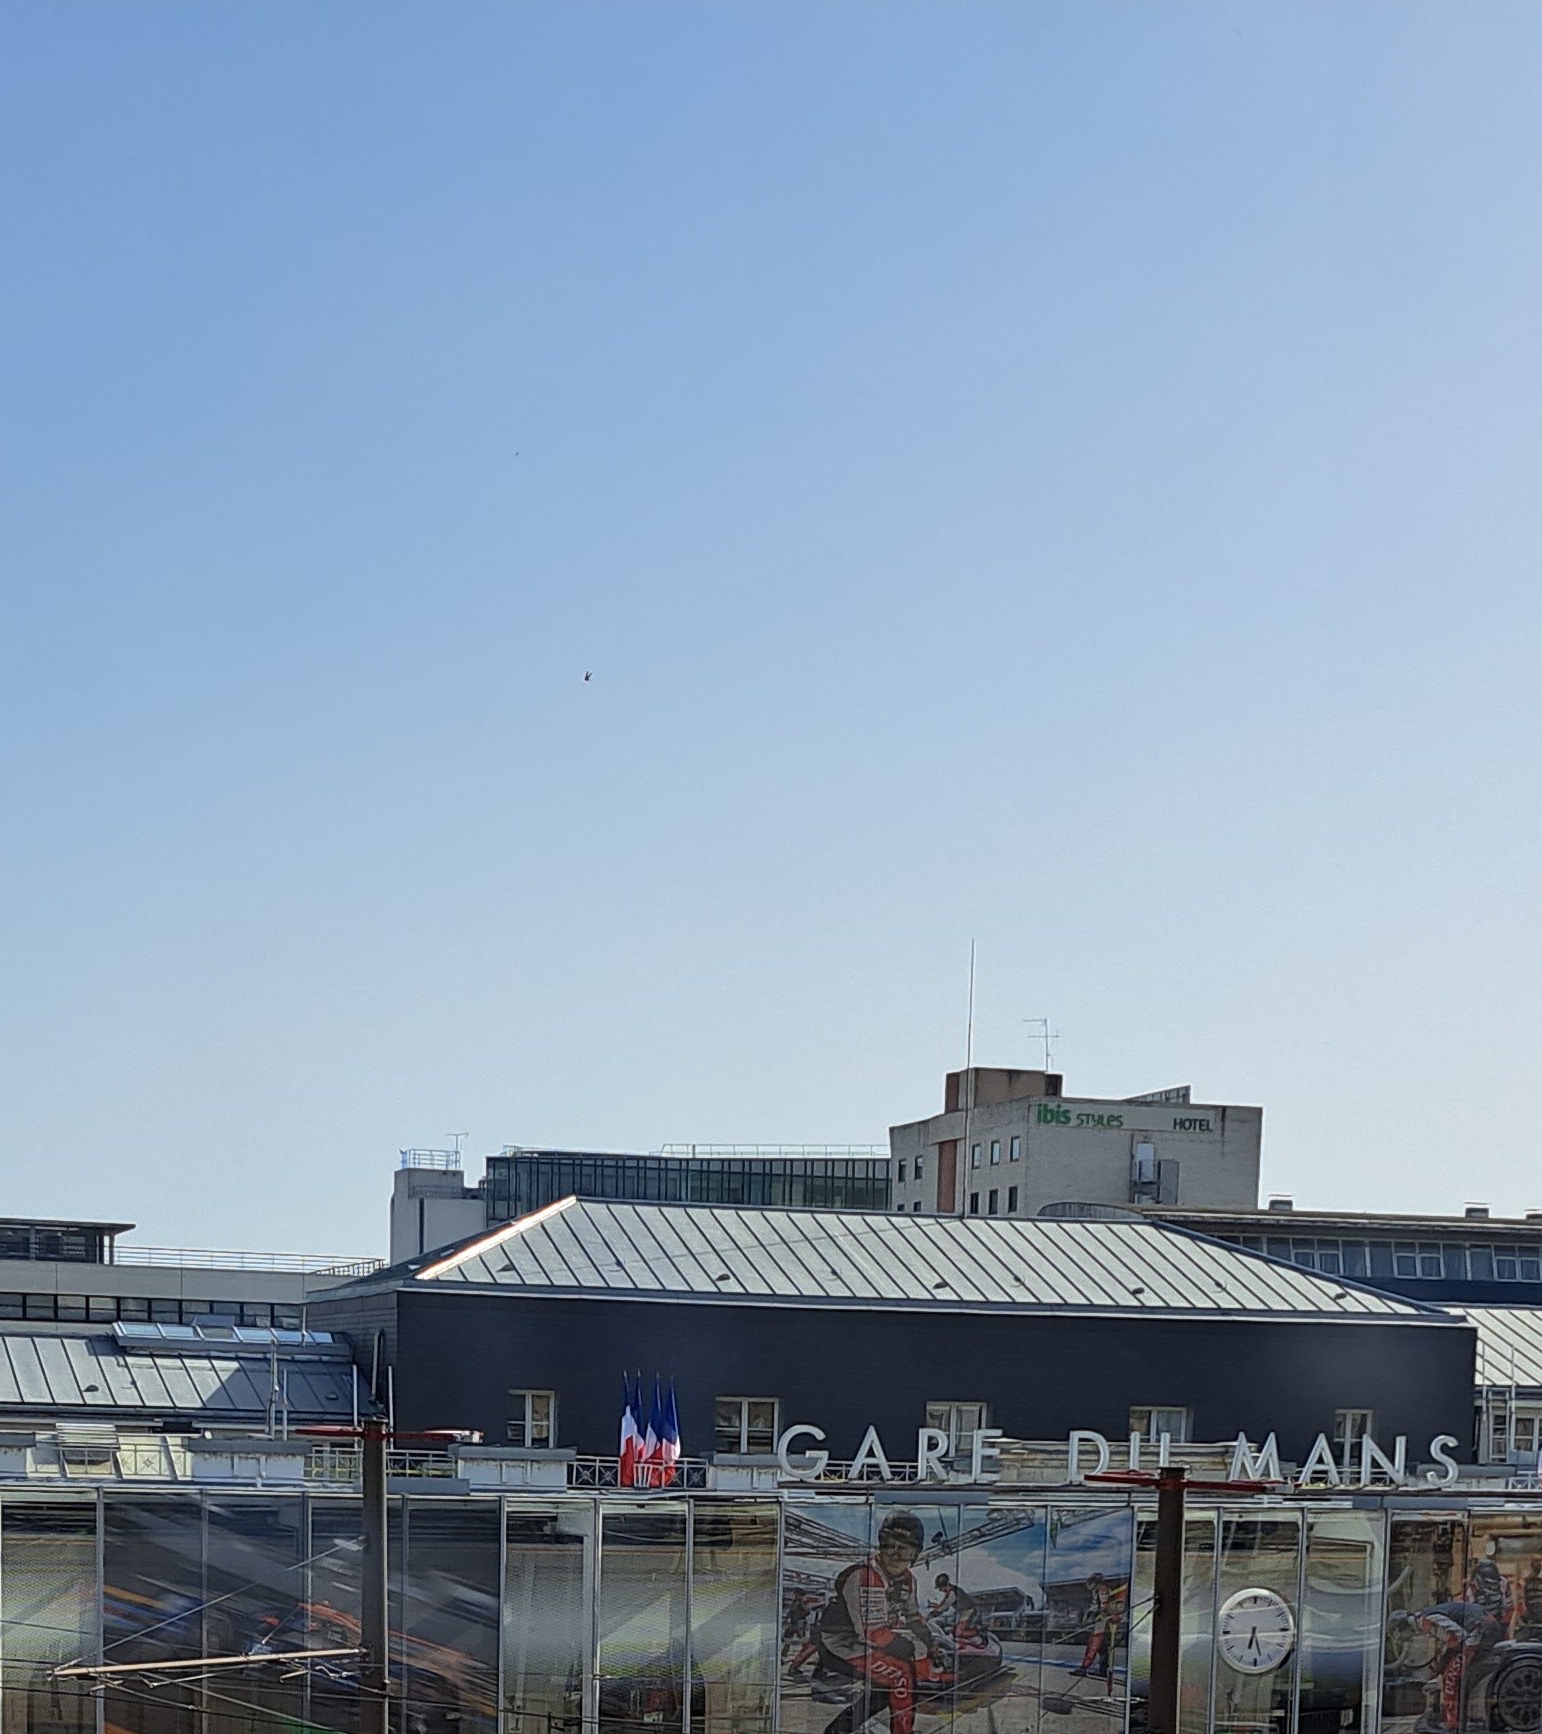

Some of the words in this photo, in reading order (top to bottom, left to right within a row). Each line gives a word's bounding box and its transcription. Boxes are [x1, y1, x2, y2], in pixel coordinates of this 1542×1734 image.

[1037, 1103, 1071, 1125] ibis
[1173, 1117, 1213, 1132] HOTEL
[776, 1423, 1003, 1484] GARE
[1068, 1430, 1171, 1484] DU
[1229, 1430, 1460, 1488] MANS
